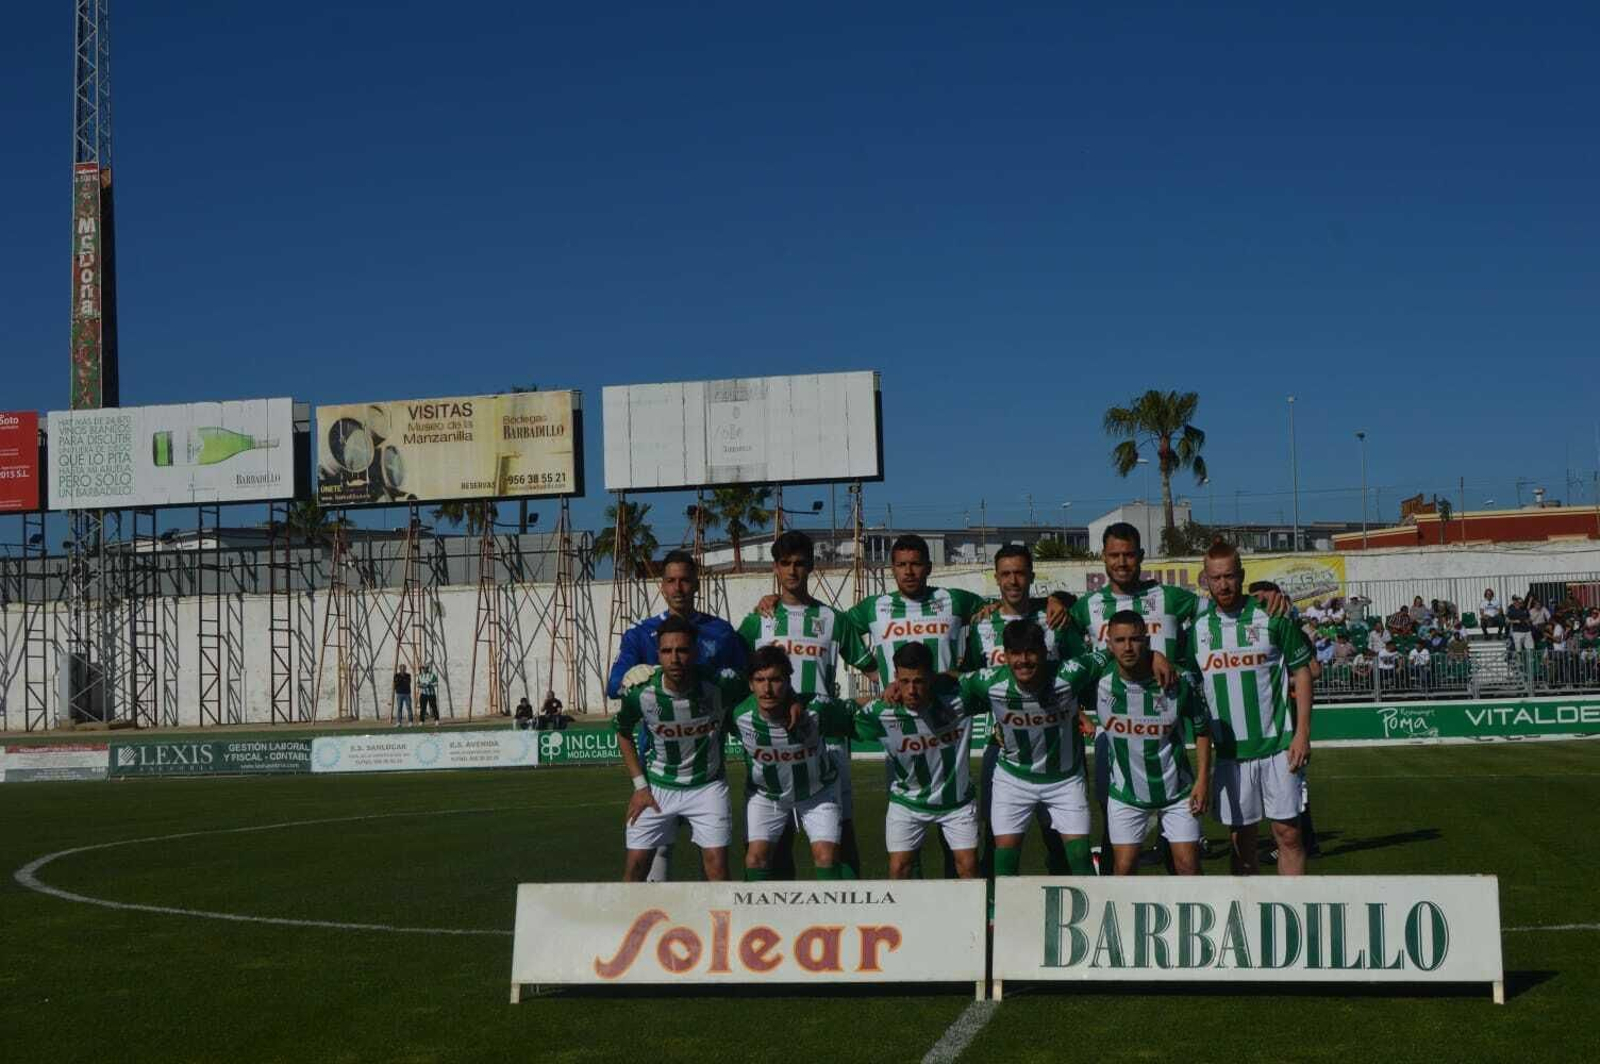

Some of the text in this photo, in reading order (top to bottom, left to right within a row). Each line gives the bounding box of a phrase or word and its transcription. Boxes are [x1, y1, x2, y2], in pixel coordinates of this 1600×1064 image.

[408, 402, 473, 420] VISITAS
[408, 420, 473, 432] Museo de la
[503, 415, 548, 425] Bodegas
[59, 433, 132, 446] PARA DISCUTIR
[403, 432, 473, 445] Manzanilla
[503, 425, 564, 440] BARBADILLO
[59, 451, 132, 467] QUE LO PITA
[59, 472, 131, 488] PERO SOLO
[236, 473, 281, 485] BARBADILLO
[461, 481, 496, 490] RESERVAS
[528, 474, 539, 484] 38
[542, 473, 553, 483] 55
[555, 472, 566, 482] 21
[882, 620, 950, 640] Solear
[1201, 652, 1268, 672] Solear
[1465, 704, 1600, 726] VITALDE
[654, 722, 718, 738] Solear
[1104, 716, 1173, 736] Solear
[229, 741, 311, 752] GESTIÓN LABORAL
[466, 740, 499, 748] AVENIDA
[566, 733, 619, 750] INCLU
[896, 728, 964, 753] Solear
[139, 744, 213, 766] LEXIS
[223, 753, 229, 762] Y
[231, 752, 263, 762] FISCAL
[270, 751, 312, 761] CONTABL
[568, 749, 622, 759] MODA CABALL
[753, 747, 817, 763] Solear
[733, 891, 897, 905] MANZANILLA
[1040, 886, 1449, 971] BARBADILLO
[594, 909, 902, 979] Solear
